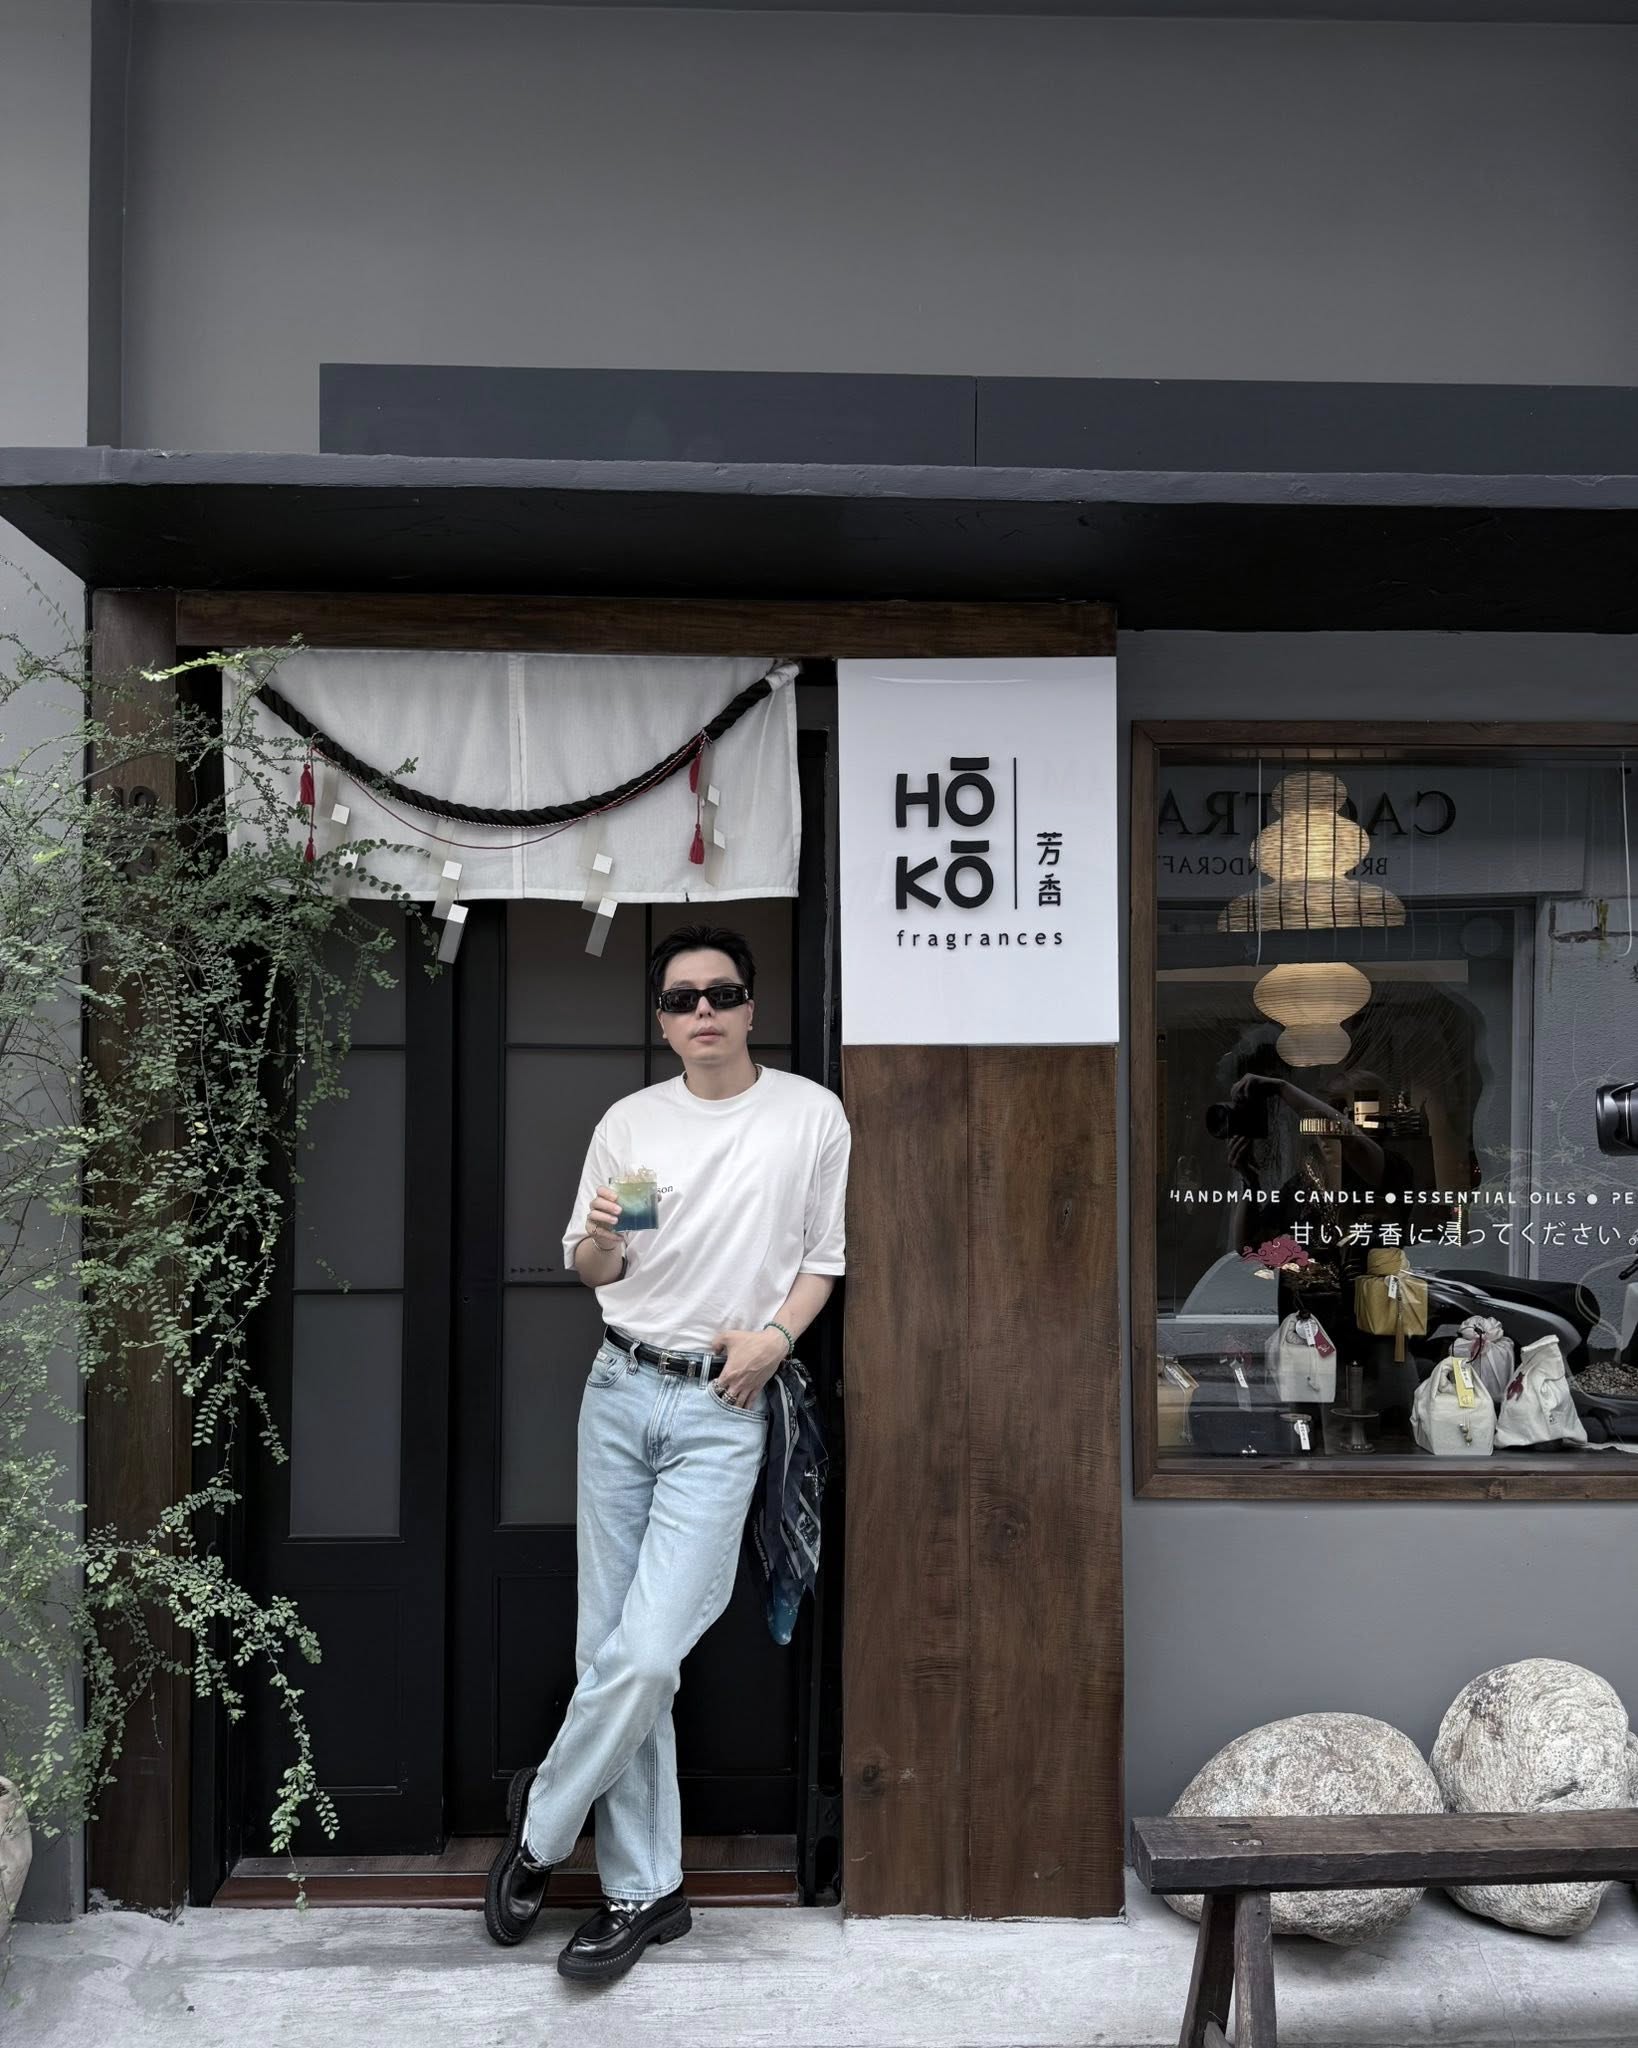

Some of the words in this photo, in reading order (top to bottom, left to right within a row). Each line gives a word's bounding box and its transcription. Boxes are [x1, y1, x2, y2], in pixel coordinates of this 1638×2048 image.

[896, 929, 1063, 950] fragrances
[1170, 1189, 1281, 1203] HANDMADE
[1294, 1190, 1375, 1203] CANDLE
[1403, 1191, 1517, 1204] ESSENTIAL
[1529, 1191, 1576, 1205] OILS
